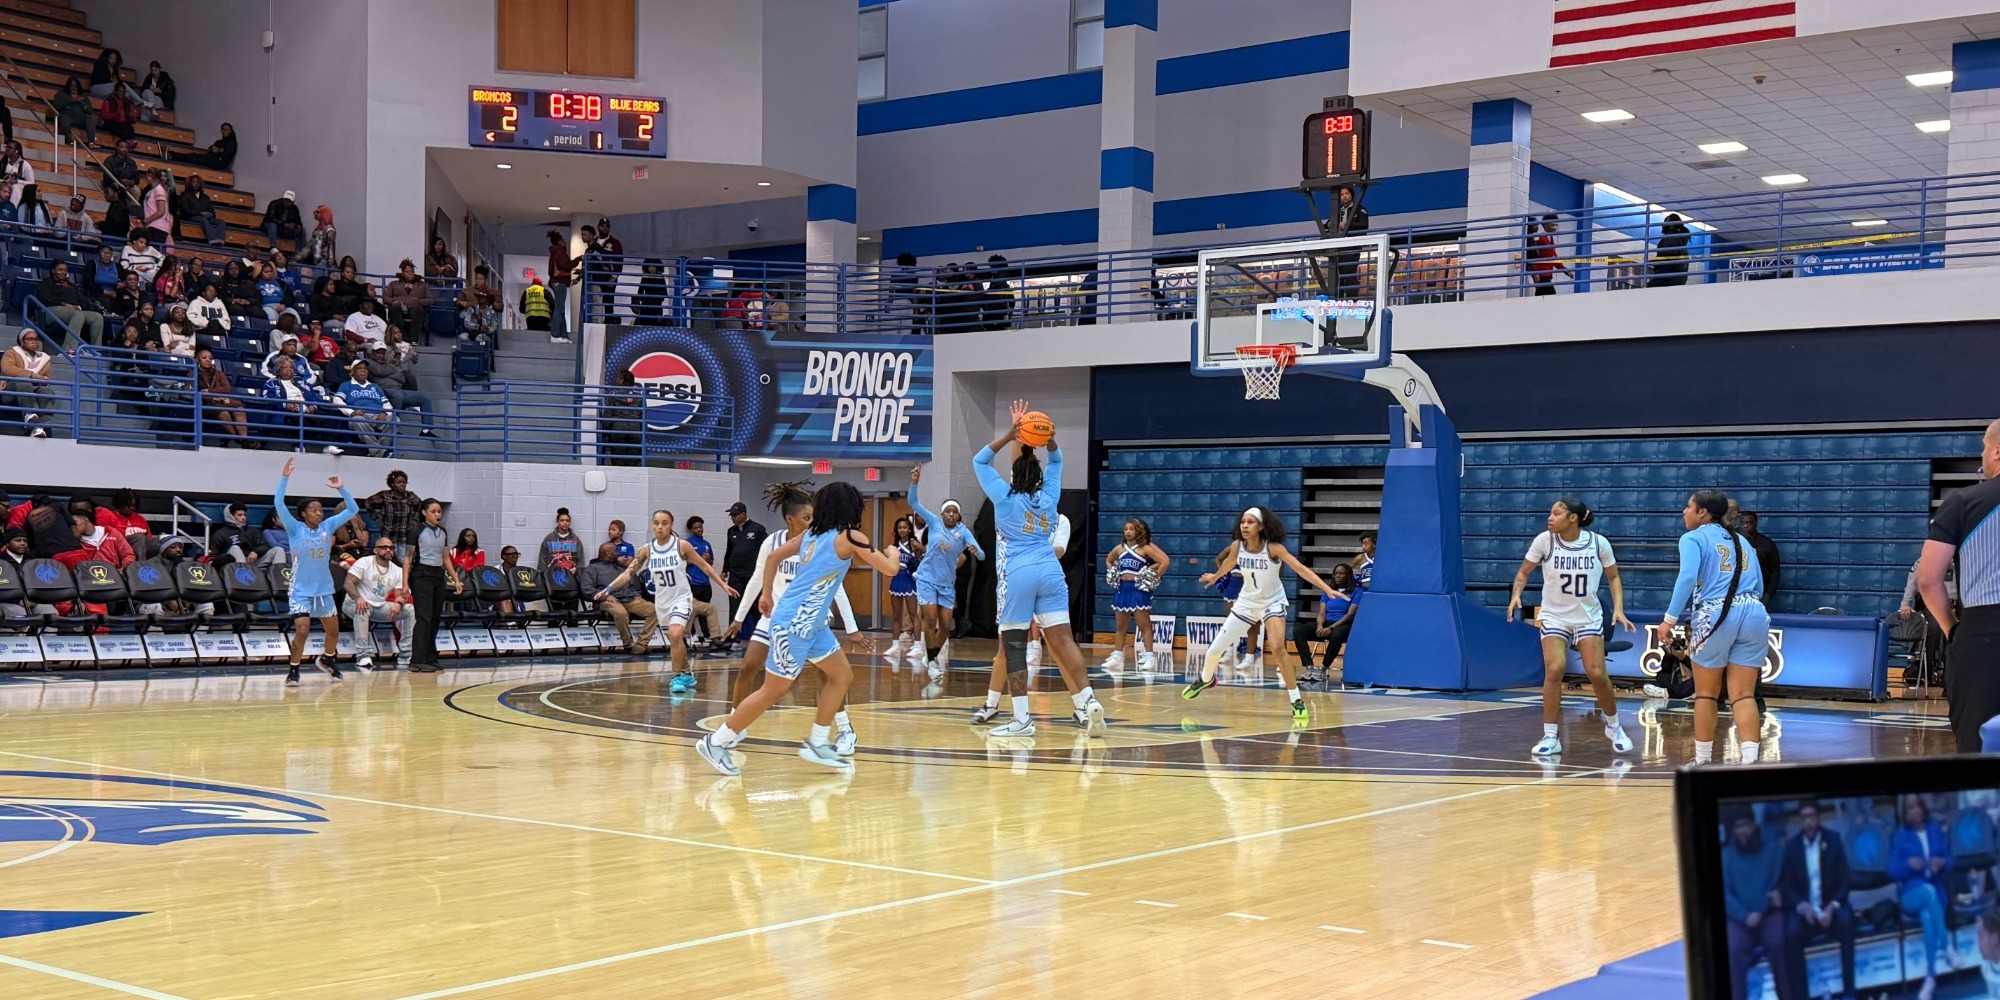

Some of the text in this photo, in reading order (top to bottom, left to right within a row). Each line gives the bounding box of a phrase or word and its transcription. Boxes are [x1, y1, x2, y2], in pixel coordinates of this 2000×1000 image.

[472, 90, 512, 103] BRONCOS
[550, 93, 602, 121] 8:38
[610, 98, 660, 113] BLUE BEARS
[502, 106, 518, 131] 2
[638, 114, 653, 139] 2
[1325, 115, 1353, 134] 8:38
[554, 134, 583, 146] period
[597, 133, 602, 149] 1
[803, 350, 913, 398] BRONCO
[831, 398, 915, 444] PRIDE
[650, 555, 679, 569] BRONCOS
[1238, 558, 1268, 570] BRONCOS
[1554, 555, 1595, 570] BRONCOS
[655, 570, 677, 588] 30
[1251, 572, 1258, 589] 1
[1560, 574, 1588, 598] 20
